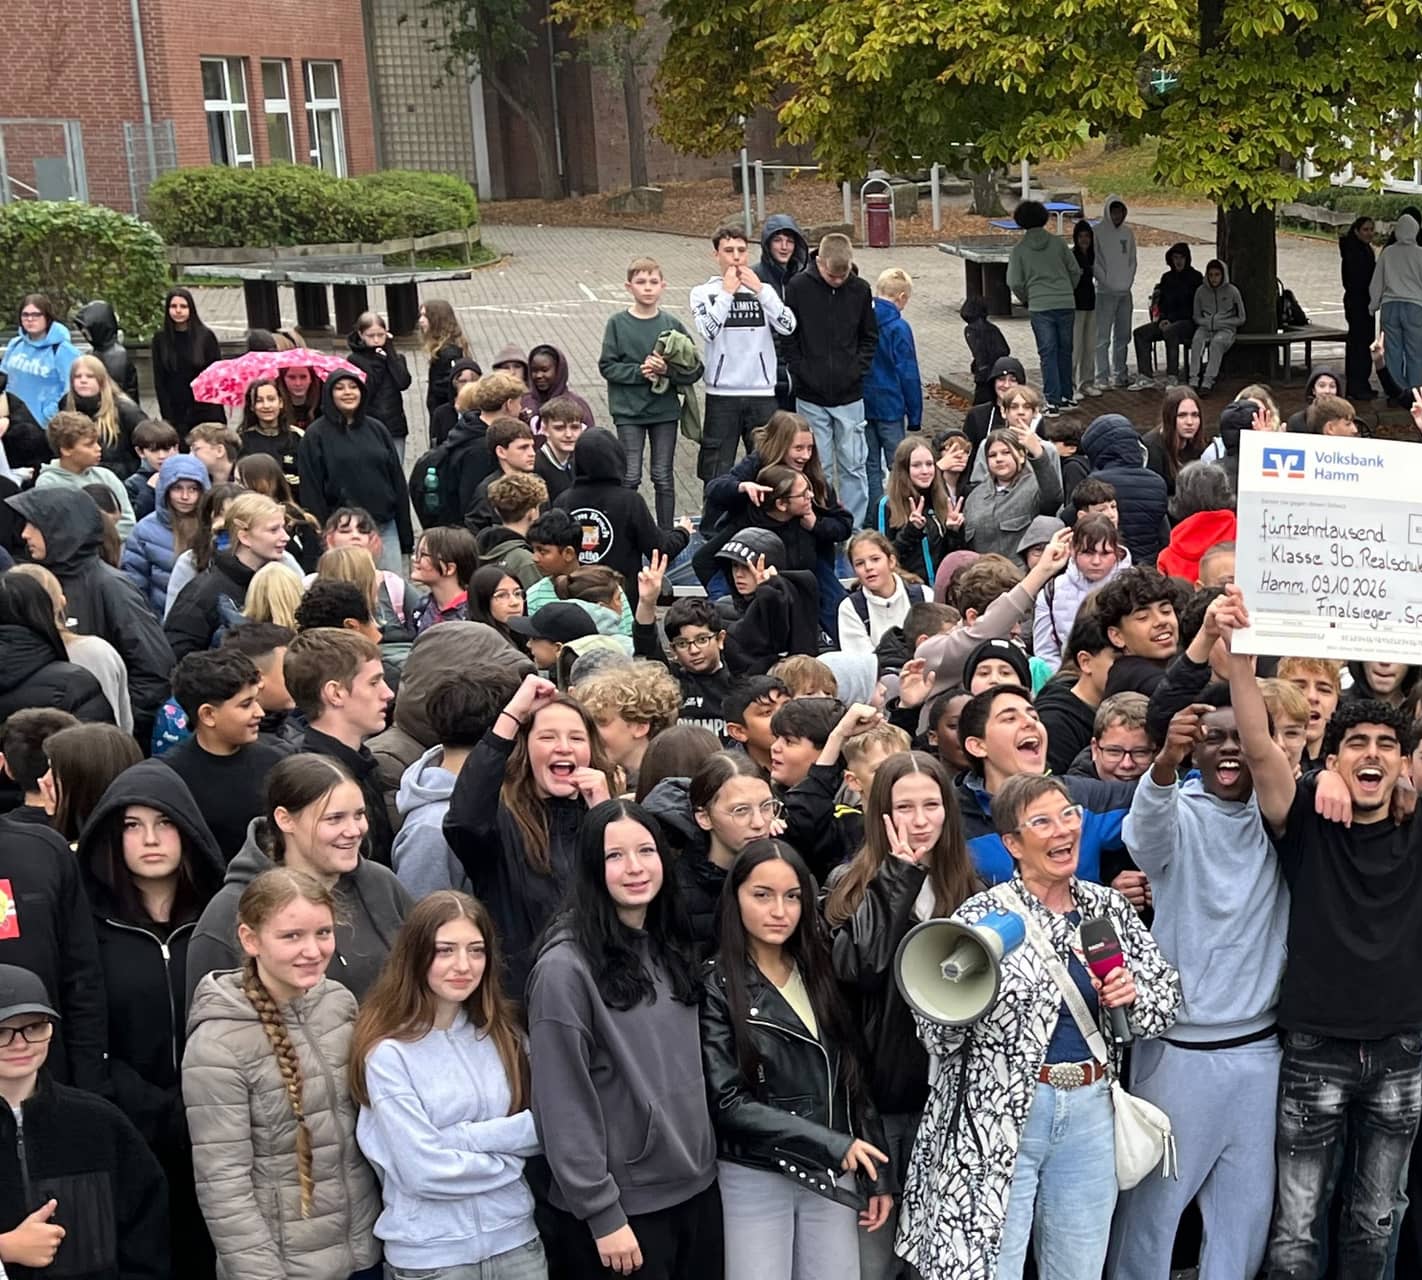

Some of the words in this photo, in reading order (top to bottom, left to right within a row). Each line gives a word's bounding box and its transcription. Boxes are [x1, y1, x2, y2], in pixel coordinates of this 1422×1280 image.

[1315, 451, 1384, 468] Volksbank
[1314, 467, 1359, 482] Hamm
[1261, 508, 1386, 542] fünfzehntausend
[1271, 544, 1323, 566] Klasse
[1316, 596, 1392, 629] Finalsieger
